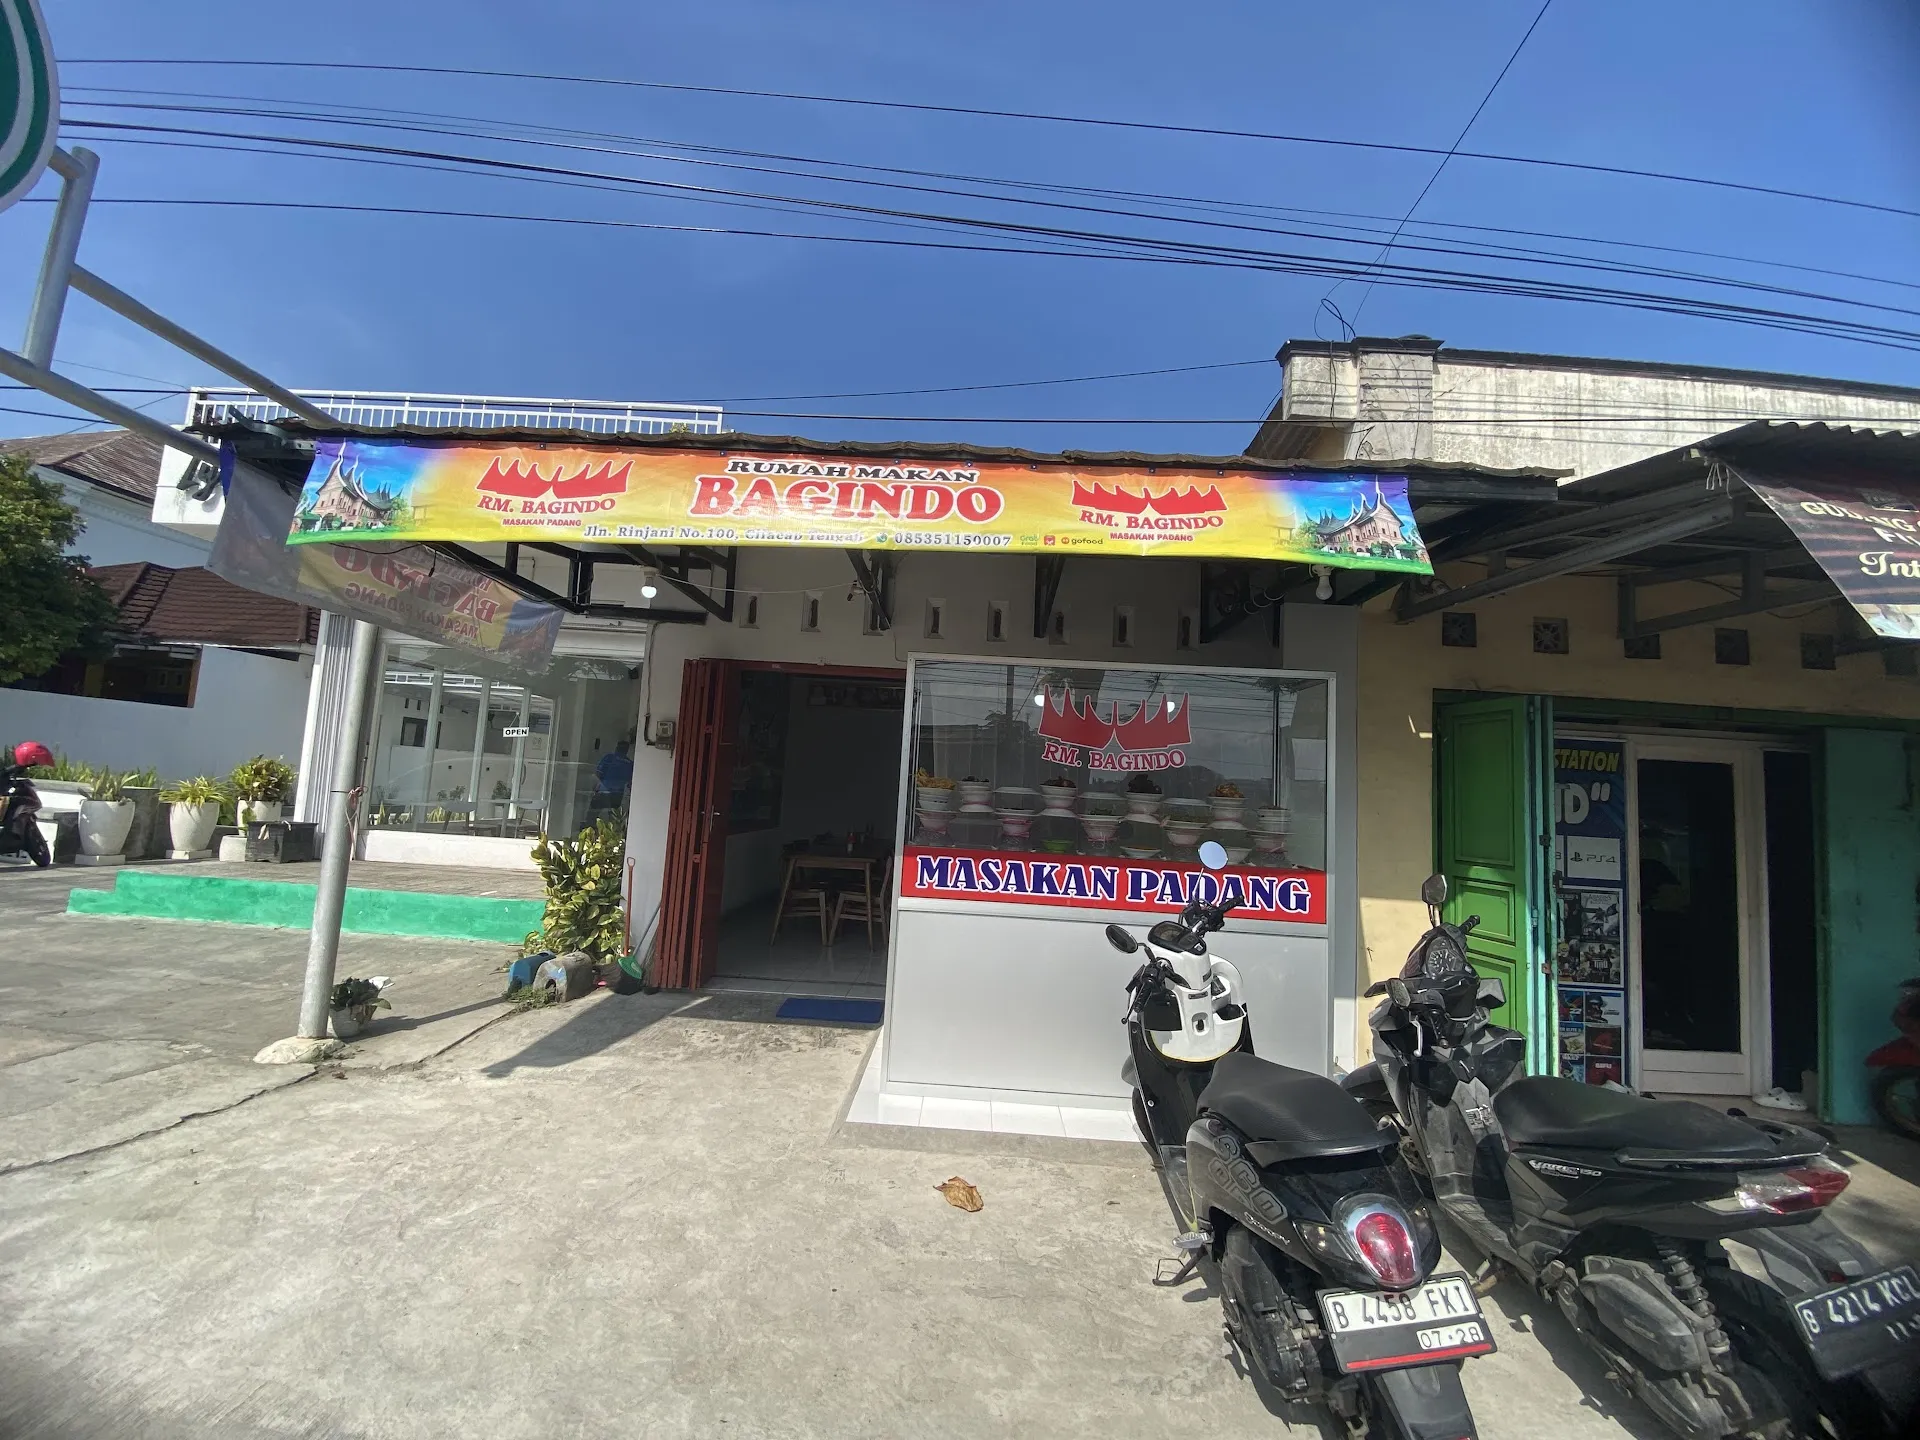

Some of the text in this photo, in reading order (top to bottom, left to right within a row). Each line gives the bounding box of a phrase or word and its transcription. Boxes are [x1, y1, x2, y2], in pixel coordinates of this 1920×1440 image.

[728, 460, 978, 482] RUMAH MAKAN
[477, 495, 616, 515] RM. BAGINDO
[690, 476, 1003, 523] BAGINDO
[502, 518, 582, 527] MASAKAN PADANG
[1079, 509, 1224, 530] RM. BAGINDO
[584, 526, 612, 537] Jln.
[617, 526, 675, 540] Rinjani
[894, 532, 1011, 546] 085351150007
[1071, 536, 1104, 546] gofood
[1110, 532, 1194, 542] MASAKAN PADANG
[505, 728, 527, 736] OPEN
[1042, 742, 1186, 772] RM. BAGINDO
[916, 854, 1310, 915] MASAKAN PADANG
[1332, 1286, 1469, 1329] B 4458 FKI
